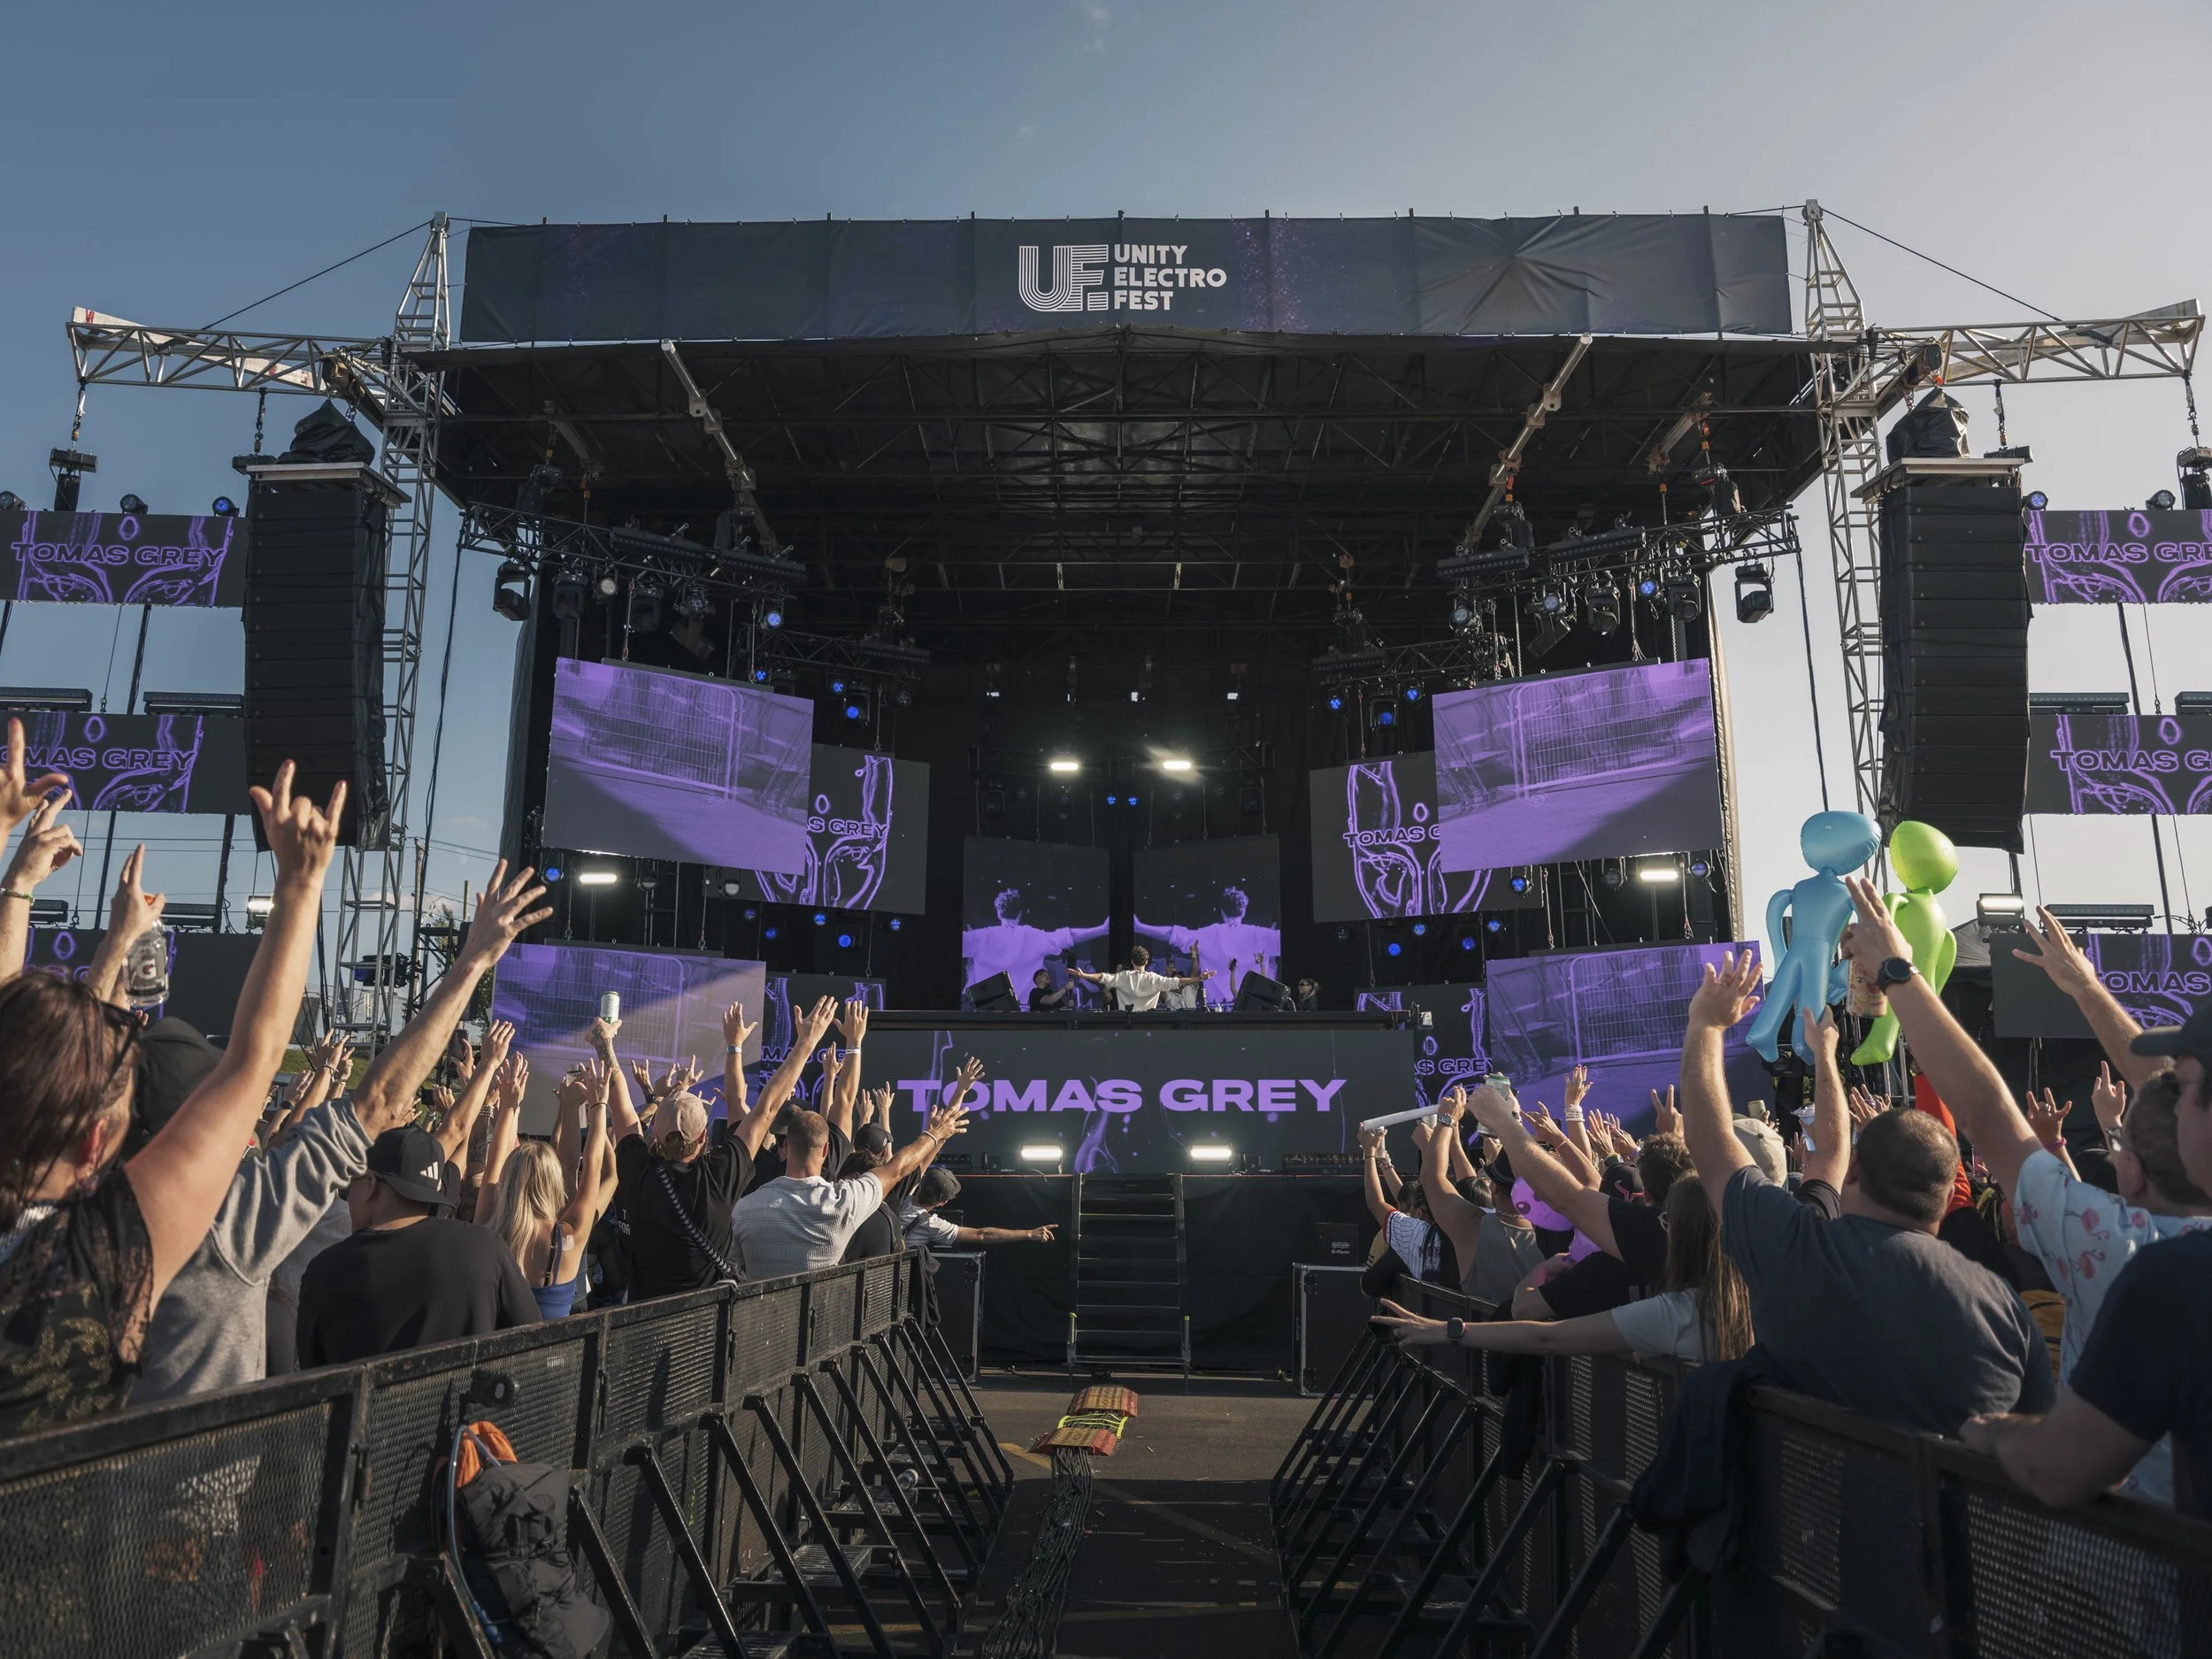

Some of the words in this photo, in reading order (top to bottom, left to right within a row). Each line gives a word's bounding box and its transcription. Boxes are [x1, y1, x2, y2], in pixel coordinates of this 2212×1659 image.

[1114, 244, 1187, 265] UNITY
[1114, 266, 1227, 288] ELECTRO
[1114, 289, 1174, 311] FEST
[12, 542, 129, 565] TOMAS
[134, 546, 225, 567] GREY
[2024, 542, 2149, 564] TOMAS
[102, 749, 196, 771] GREY
[2050, 750, 2179, 772] TOMAS
[828, 818, 887, 838] GREY
[1343, 826, 1425, 848] TOMAS
[897, 1079, 1142, 1113] TOMAS
[1159, 1079, 1348, 1112] GREY
